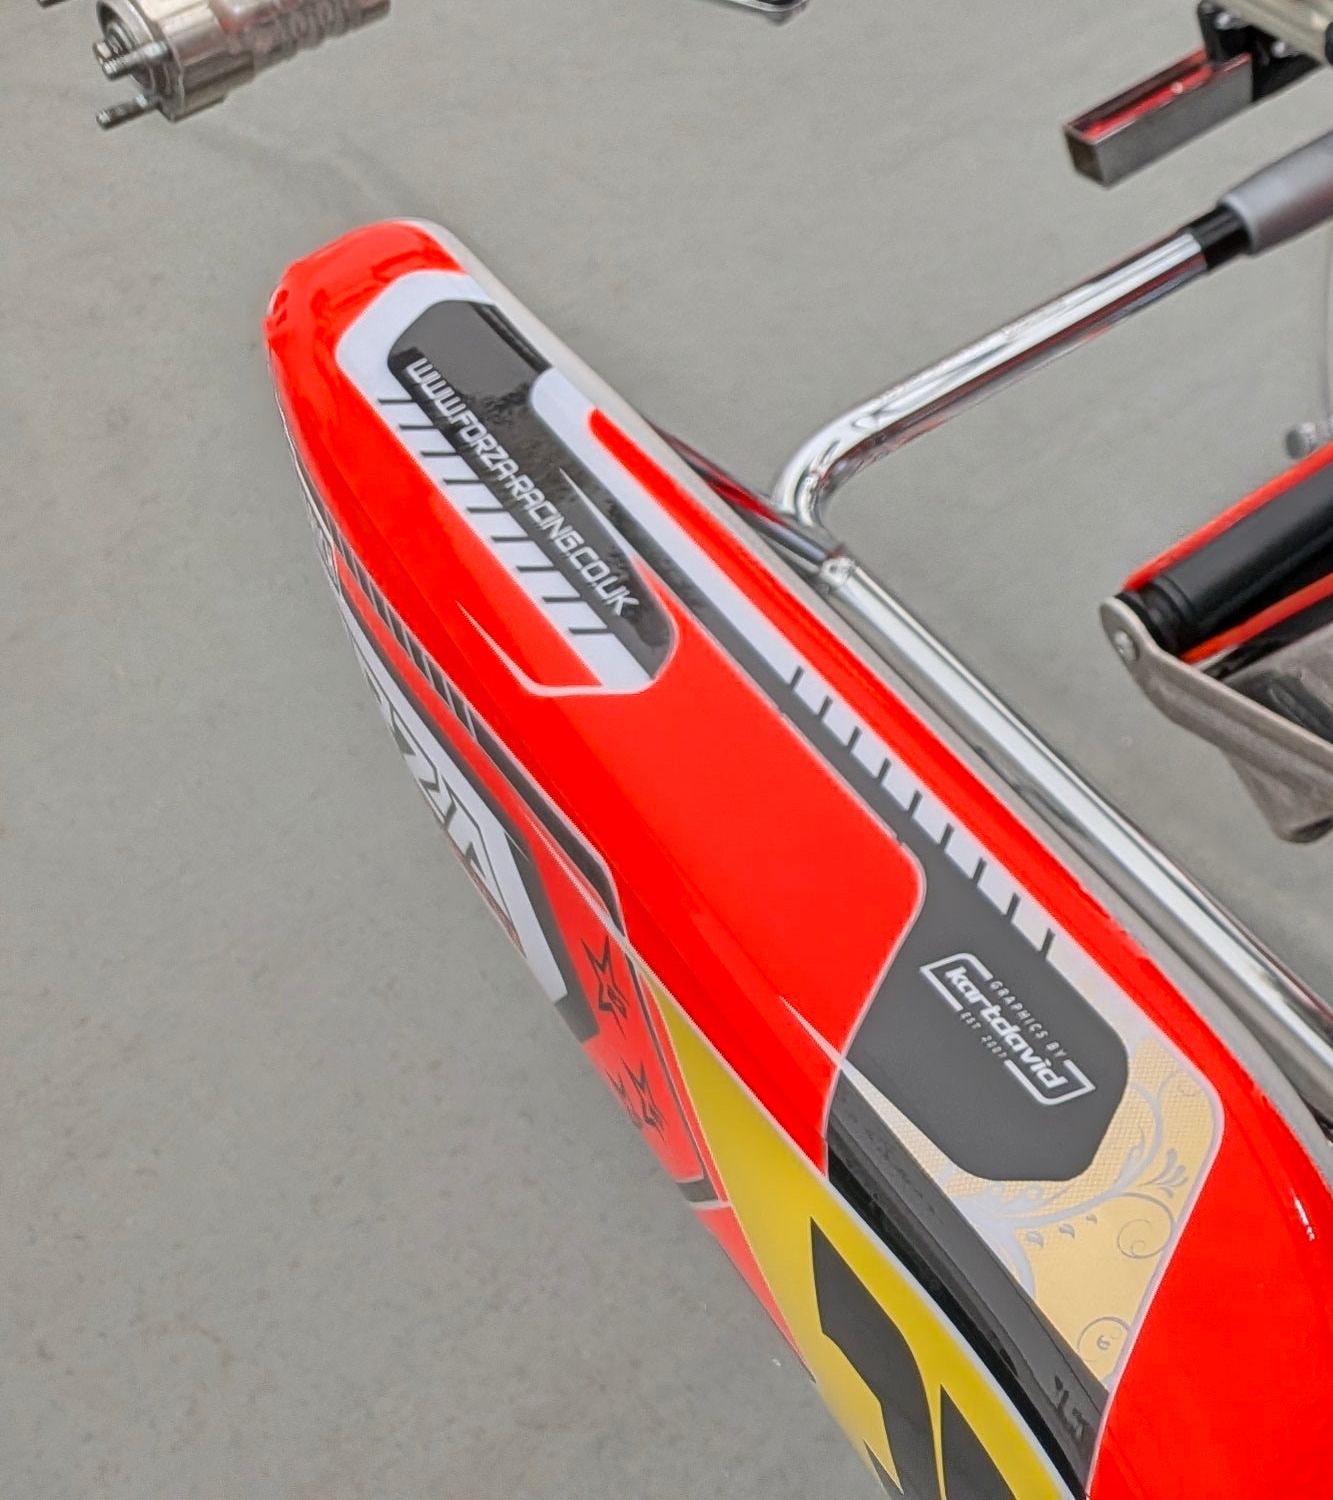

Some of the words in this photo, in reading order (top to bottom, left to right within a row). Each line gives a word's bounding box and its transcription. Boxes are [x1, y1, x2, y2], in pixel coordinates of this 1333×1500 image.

[944, 965, 1069, 1089] kartdavid
[960, 1011, 982, 1030] EST
[988, 980, 1049, 1040] GRAPHICS
[1045, 1041, 1067, 1059] BY
